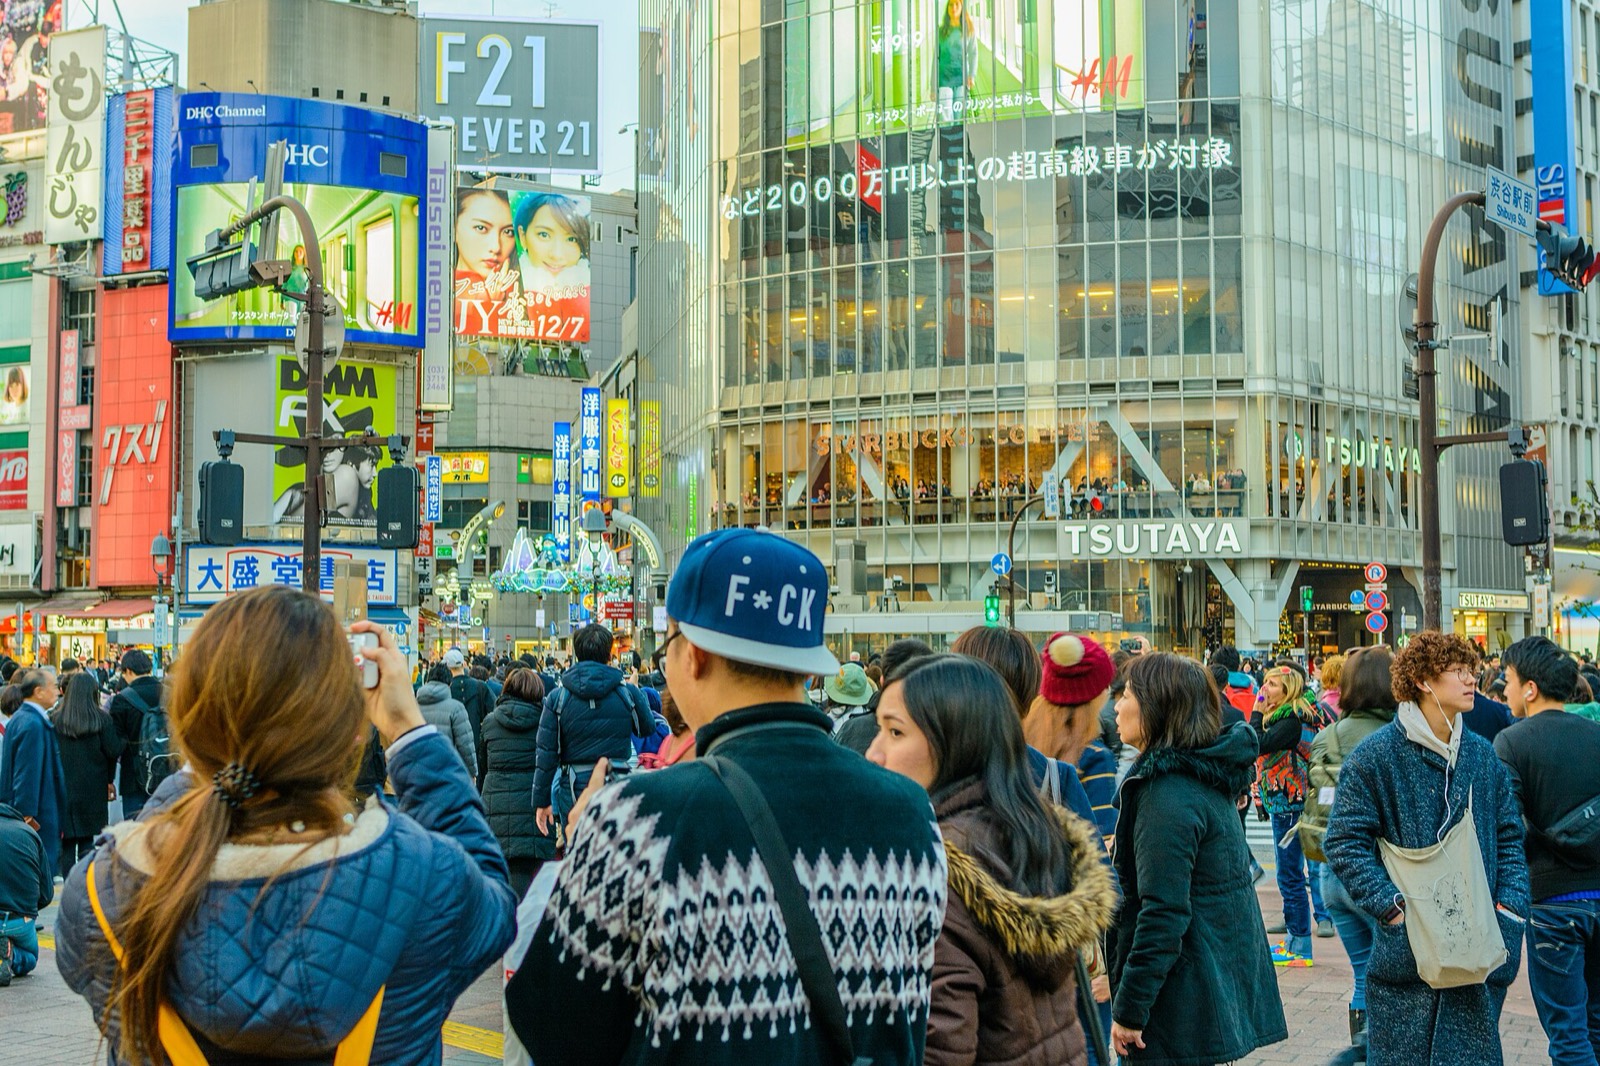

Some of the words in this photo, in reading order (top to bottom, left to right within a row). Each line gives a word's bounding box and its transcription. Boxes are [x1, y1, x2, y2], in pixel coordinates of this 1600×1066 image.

[436, 32, 546, 108] F21
[1071, 54, 1133, 101] H&M
[186, 106, 213, 120] DHC
[215, 105, 266, 118] Channel
[50, 51, 100, 234] もんじゃ
[557, 121, 590, 156] 21
[122, 97, 148, 262] 三千里薬品
[1490, 175, 1533, 215] 渋谷駅前
[428, 161, 447, 252] Taisei
[1496, 204, 1517, 224] Shibuya
[428, 259, 442, 335] neon
[455, 299, 502, 334] JY
[537, 315, 585, 339] 12/7
[582, 394, 600, 492] 洋服の青山
[816, 428, 976, 457] STARBUCKS
[1325, 436, 1421, 475] TSUTAYA
[612, 475, 625, 487] 4F
[1064, 522, 1242, 555] TSUTAYA
[1460, 594, 1496, 607] TSUTAYA
